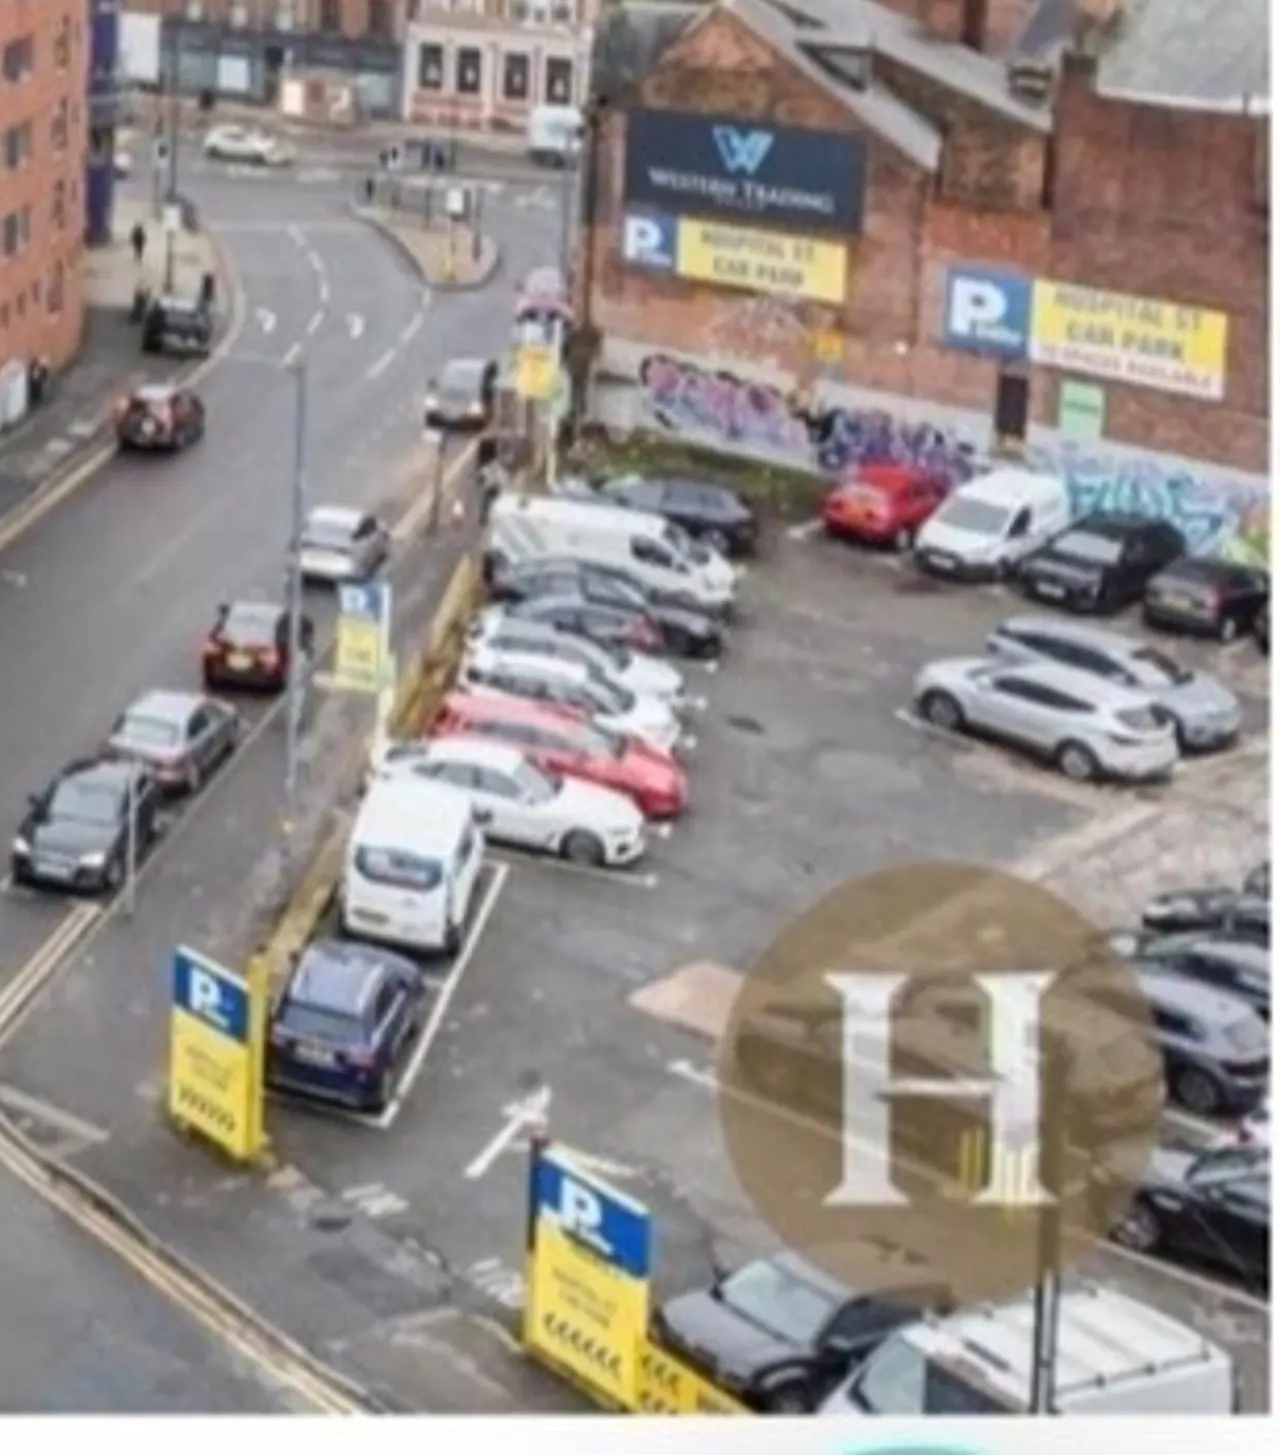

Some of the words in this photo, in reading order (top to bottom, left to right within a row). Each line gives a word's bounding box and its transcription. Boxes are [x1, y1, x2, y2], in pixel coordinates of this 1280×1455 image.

[624, 214, 663, 260] P
[949, 276, 1008, 336] P
[1066, 320, 1115, 346] CAR
[1121, 329, 1185, 360] PARK
[190, 964, 221, 1012] P
[560, 1176, 603, 1229] P
